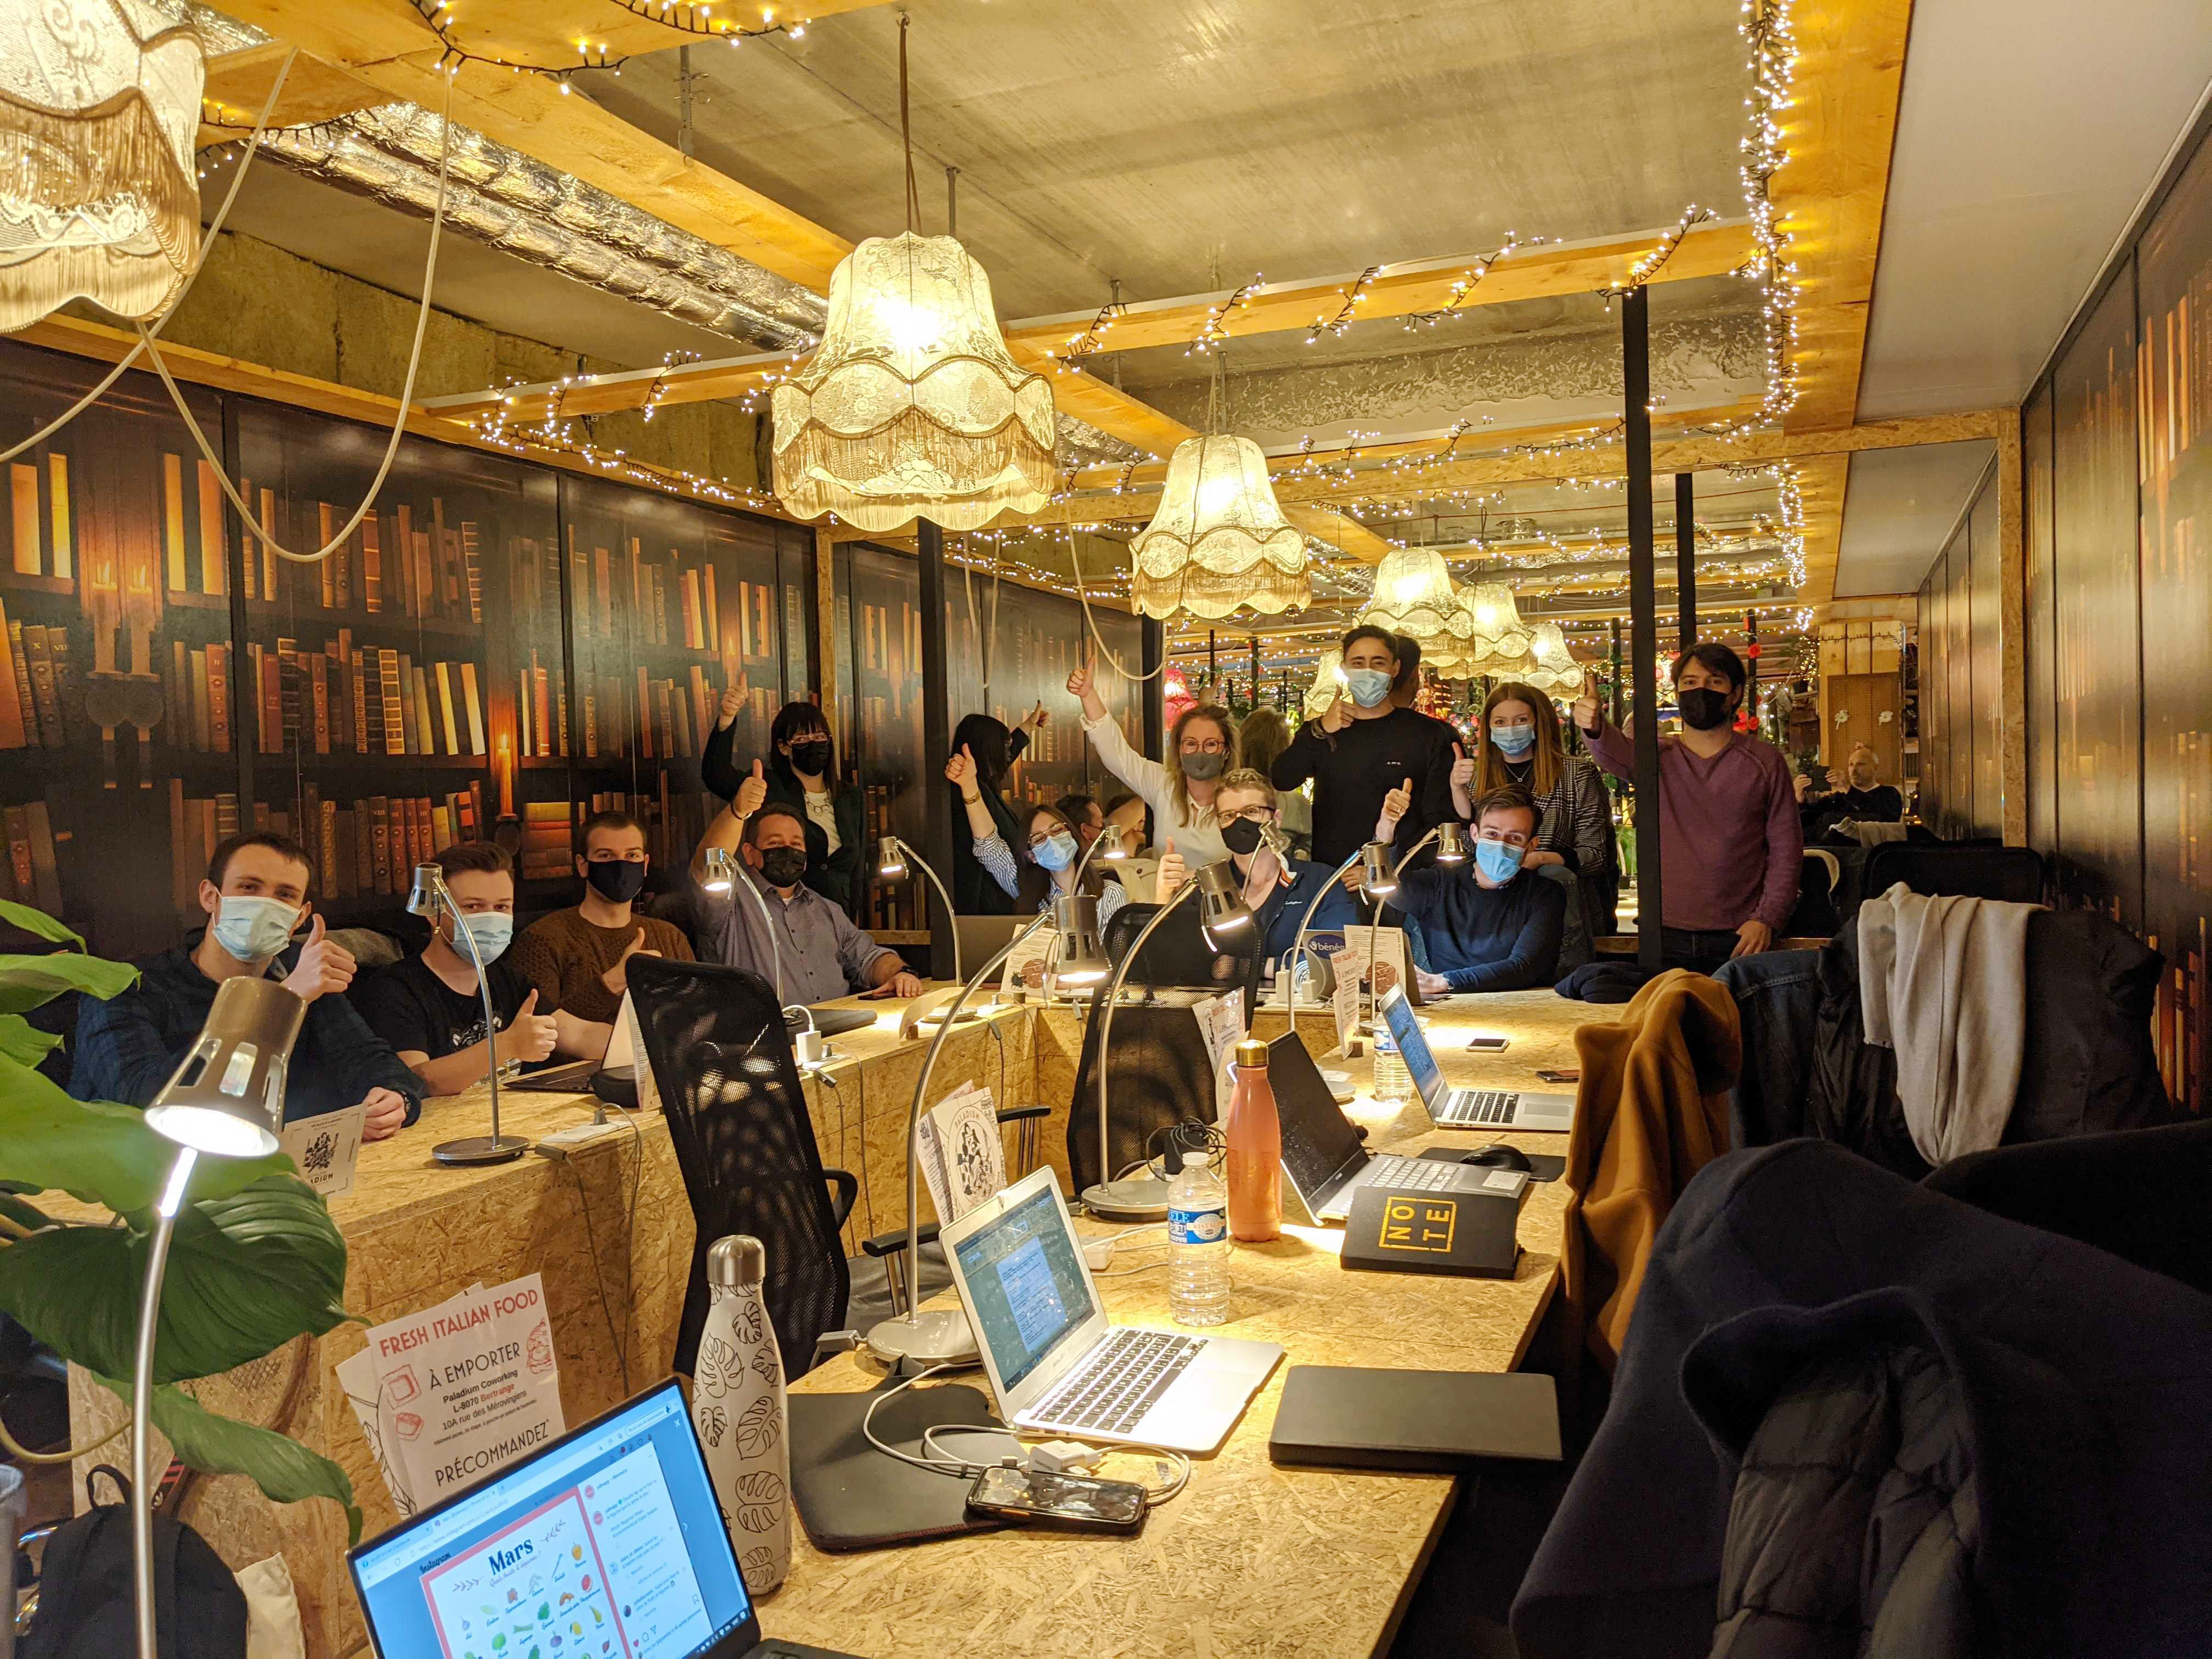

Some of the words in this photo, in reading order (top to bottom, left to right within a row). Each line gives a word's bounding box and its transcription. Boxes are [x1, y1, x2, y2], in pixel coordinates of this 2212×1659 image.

[955, 1110, 979, 1129] PALADIUM
[311, 1173, 334, 1184] ADIUM
[379, 1326, 429, 1357] FRESH
[432, 1305, 491, 1339] ITALIAN
[494, 1289, 538, 1317] FOOD
[431, 1369, 442, 1390] À
[444, 1342, 520, 1383] EMPORTER
[443, 1385, 479, 1403] Paladium
[481, 1370, 518, 1389] Coworking
[453, 1397, 479, 1413] L-8070
[481, 1384, 515, 1402] Bertrange
[443, 1419, 458, 1430] 10A
[459, 1414, 471, 1423] rue
[473, 1407, 486, 1418] des
[487, 1390, 527, 1411] Mérovingiens
[419, 1553, 452, 1573] Instagram
[488, 1538, 534, 1576] Mars
